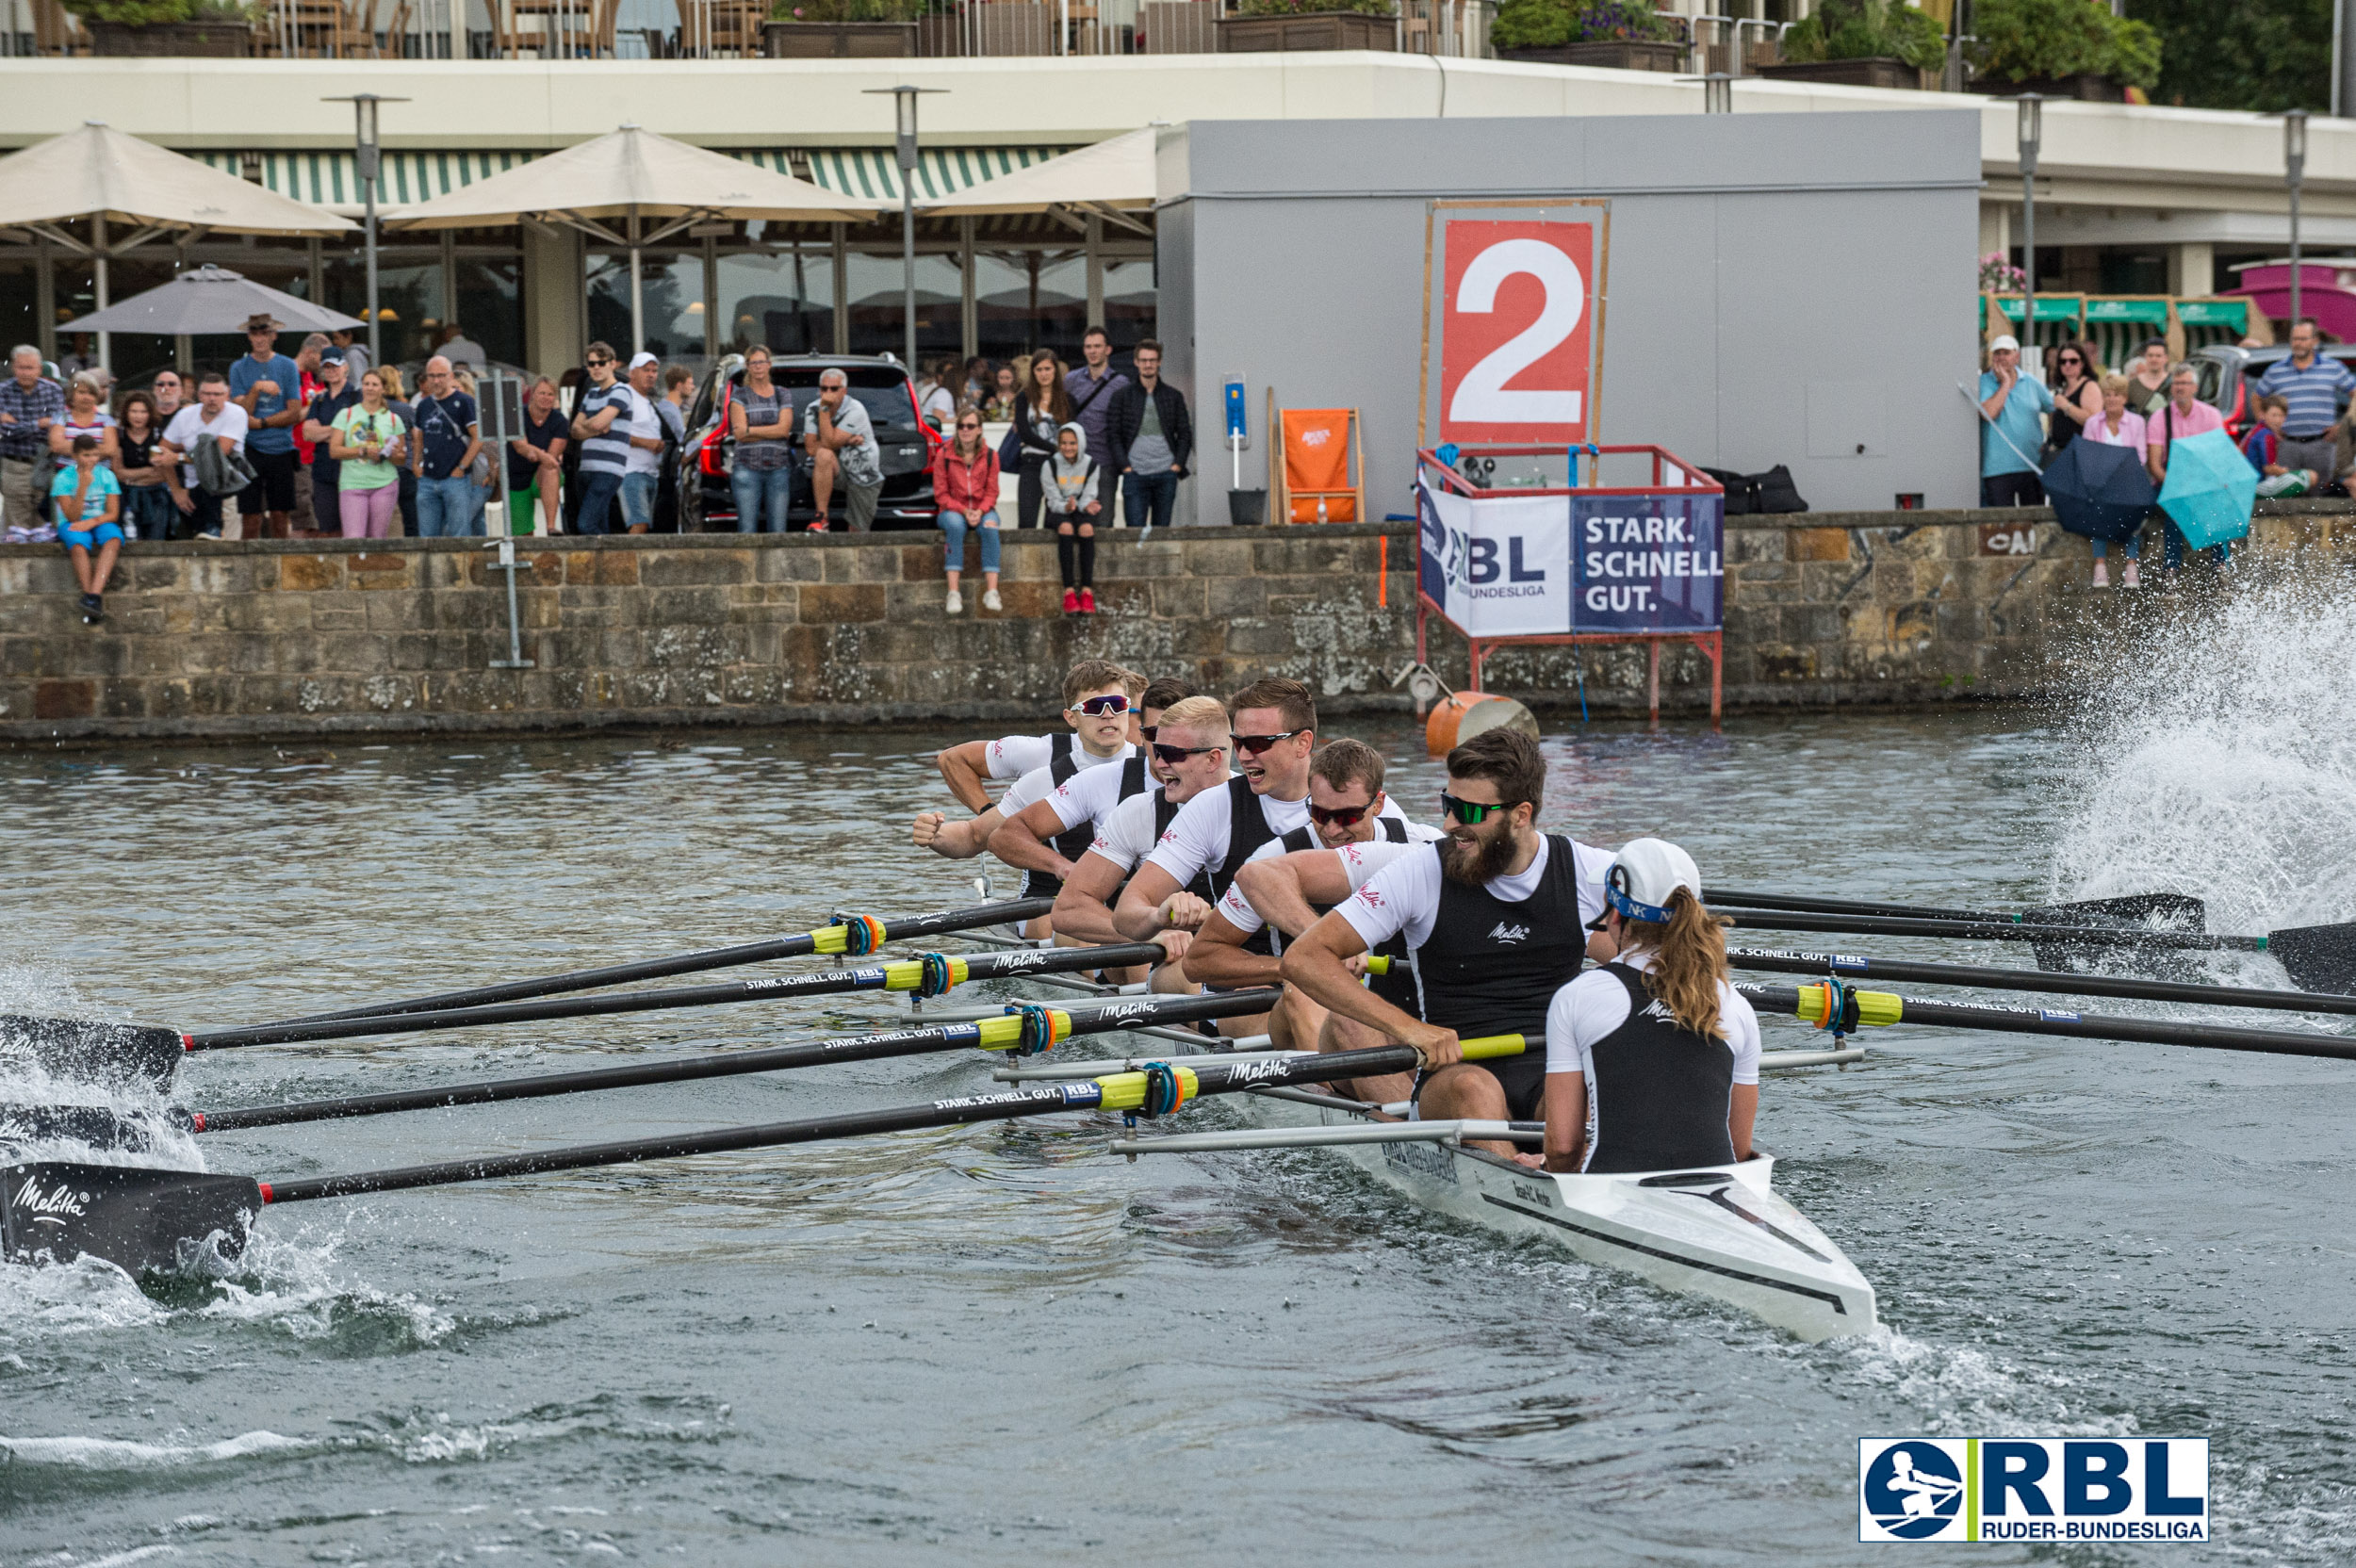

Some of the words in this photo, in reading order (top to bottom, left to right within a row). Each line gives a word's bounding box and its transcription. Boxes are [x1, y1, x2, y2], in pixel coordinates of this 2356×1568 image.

[1448, 238, 1584, 424] 2
[1585, 516, 1695, 544] STARK.
[1468, 536, 1546, 584] BL
[1468, 586, 1546, 599] UNDESLIGA
[1585, 585, 1657, 612] GUT.
[1628, 903, 1647, 918] NK
[1660, 910, 1674, 922] N
[1746, 948, 1799, 960] SCHNELL.
[1801, 952, 1827, 962] GUT.
[745, 977, 781, 989] STARK.
[783, 974, 827, 986] SCHNELL.
[827, 972, 852, 981] GUT.
[857, 968, 884, 977] RBL
[824, 1037, 861, 1049] STARK.
[863, 1032, 914, 1044] SCHNELL.
[914, 1028, 941, 1037] GUT.
[1227, 1059, 1291, 1084] Melitta
[934, 1098, 976, 1110] STARK.
[973, 1091, 1032, 1105] SCHNELL.
[1032, 1087, 1060, 1100] GUT.
[1065, 1084, 1099, 1095] RBL
[11, 1175, 86, 1217] Melitta
